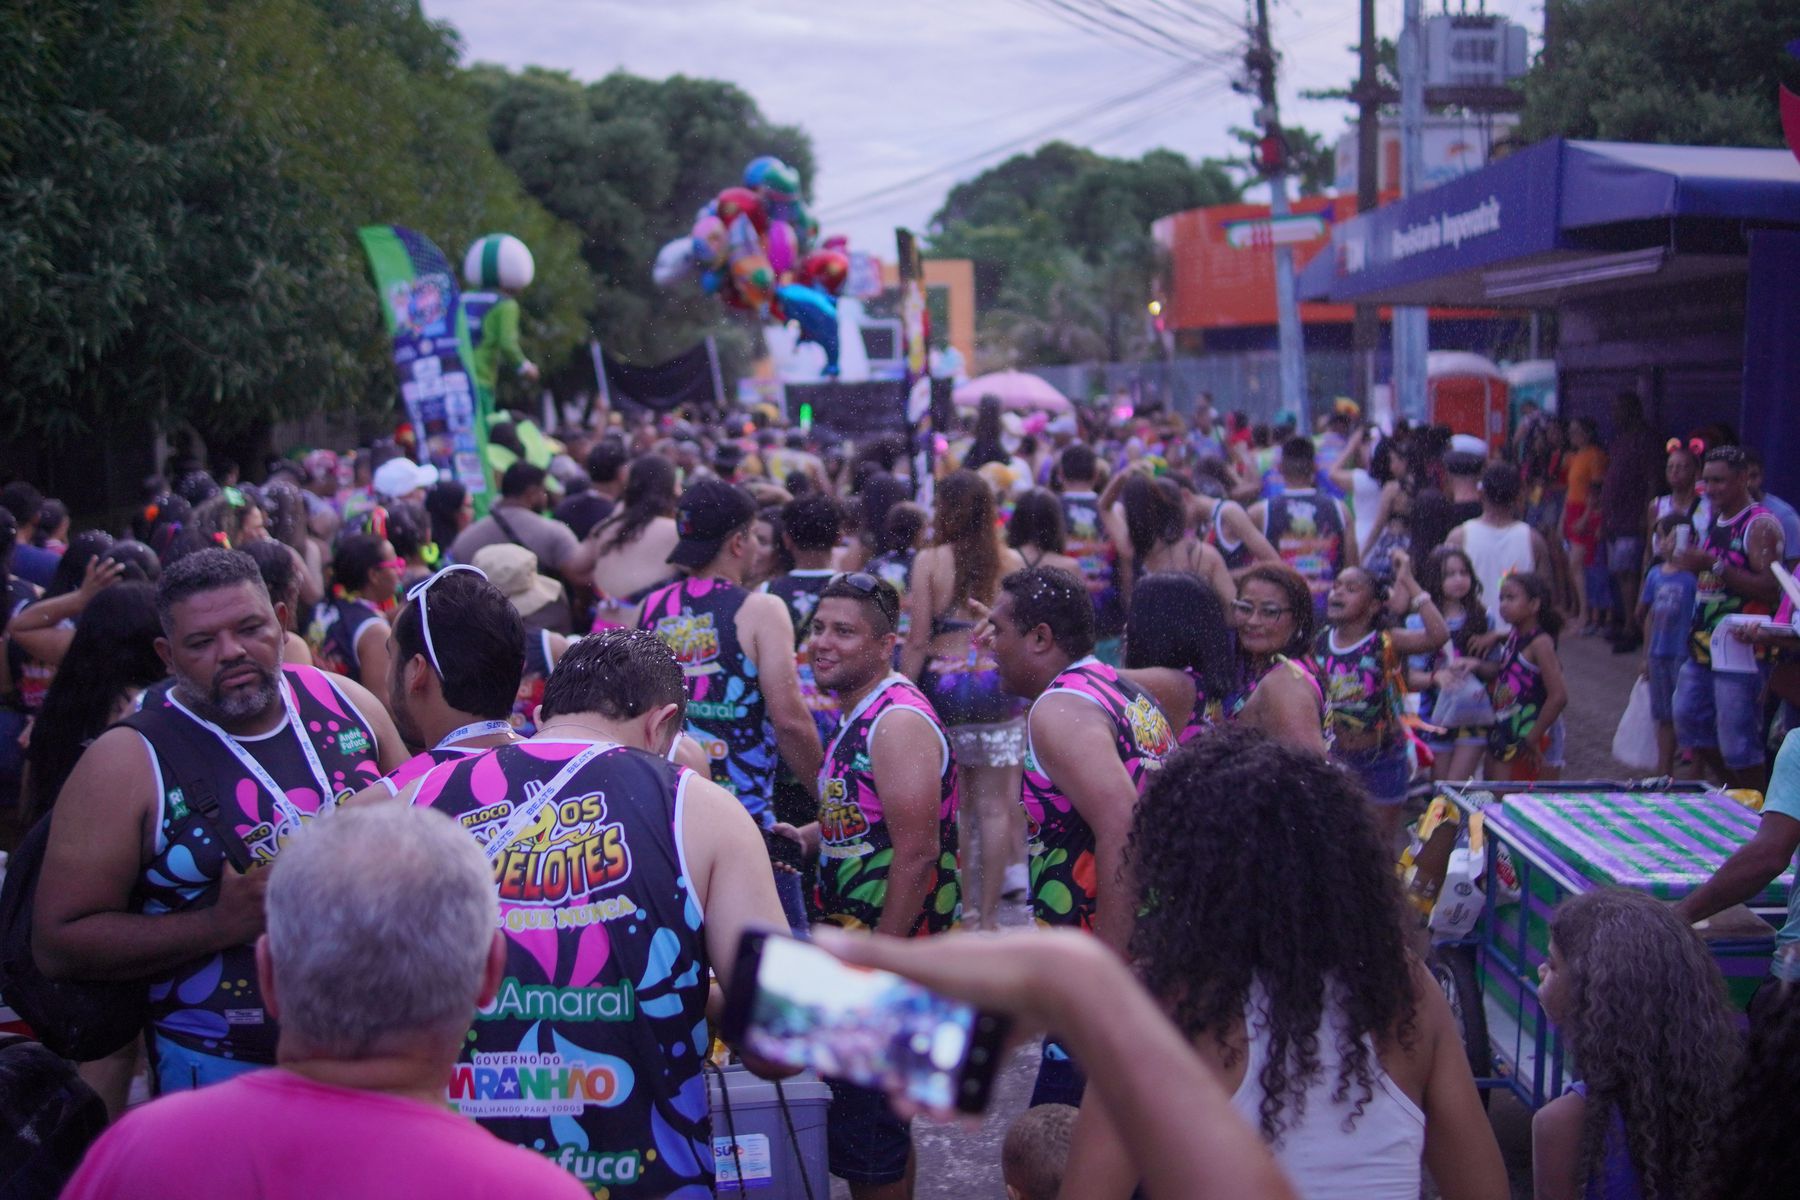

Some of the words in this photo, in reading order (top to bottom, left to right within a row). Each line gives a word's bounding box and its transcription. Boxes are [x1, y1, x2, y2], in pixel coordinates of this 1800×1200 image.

[687, 702, 734, 719] maral
[566, 750, 595, 775] BEATS
[461, 803, 510, 828] BLOCO
[558, 794, 602, 828] OS
[526, 786, 555, 816] BEATS
[486, 828, 515, 859] BEATS
[507, 908, 556, 933] QUE
[556, 895, 637, 928] NUNCA
[475, 1055, 537, 1065] GOVERNO
[543, 1056, 561, 1065] DO
[461, 1105, 521, 1114] TRABALHANDO
[524, 1105, 547, 1113] PARA
[552, 1105, 582, 1113] TODOS
[550, 1147, 636, 1180] fuca
